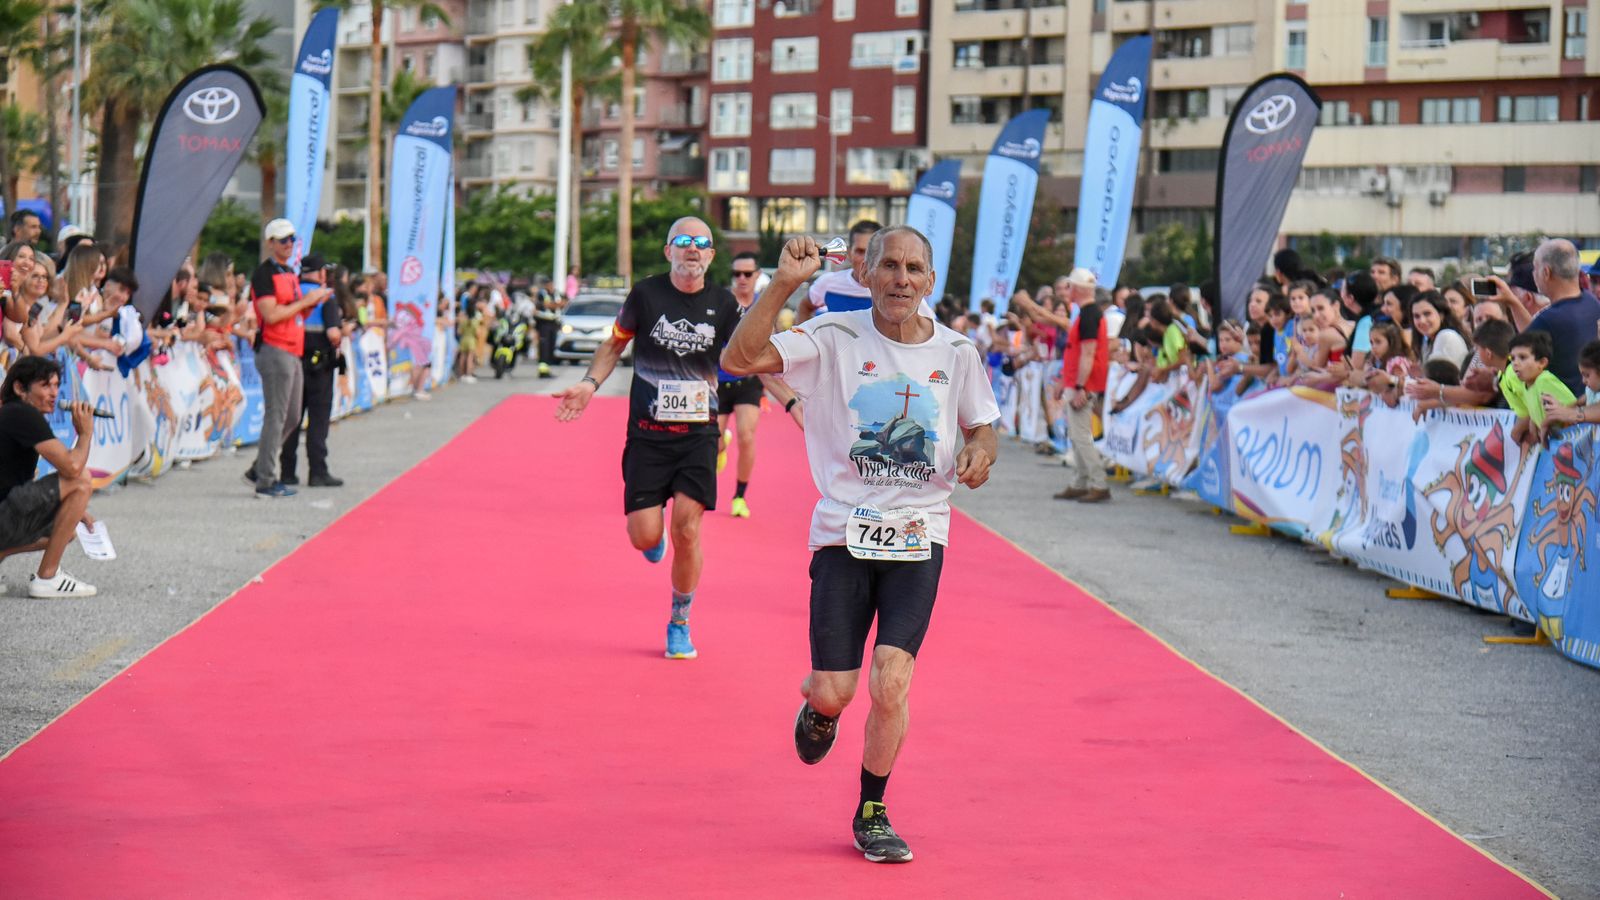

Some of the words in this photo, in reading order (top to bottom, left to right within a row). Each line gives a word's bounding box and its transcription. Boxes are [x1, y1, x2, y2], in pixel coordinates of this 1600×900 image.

[178, 133, 241, 153] TOMAX
[1247, 136, 1303, 162] TOMAX
[996, 173, 1018, 274] Sergeyco
[655, 338, 708, 353] TRAIL
[662, 394, 688, 410] 304
[854, 455, 885, 478] Vive
[886, 459, 901, 478] la
[903, 461, 932, 482] vida
[854, 507, 870, 517] XXI
[858, 523, 897, 547] 742
